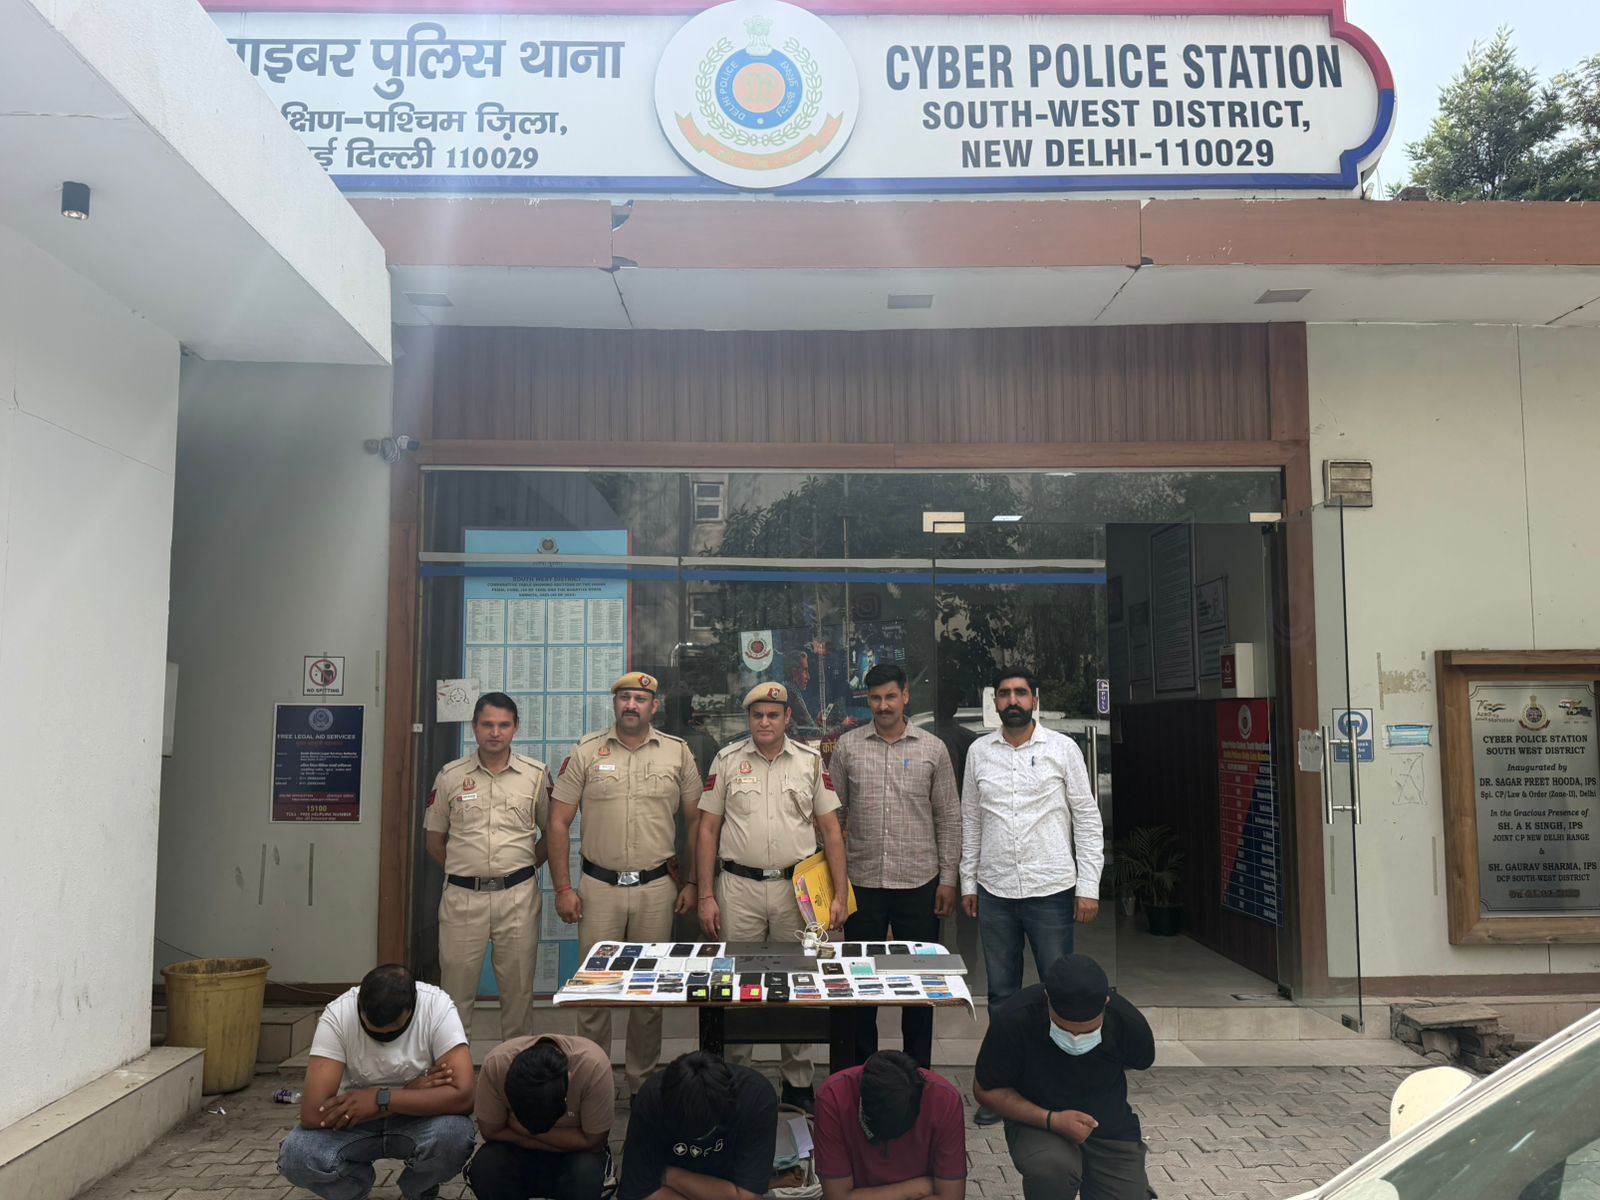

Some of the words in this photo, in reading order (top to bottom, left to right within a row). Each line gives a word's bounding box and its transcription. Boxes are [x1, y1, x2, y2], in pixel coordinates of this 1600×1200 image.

[370, 22, 506, 100] पुलिस
[519, 41, 625, 78] थाना
[885, 44, 1013, 91] CYBER
[1029, 44, 1168, 89] POLICE
[1183, 43, 1342, 89] STATION
[720, 60, 739, 95] POLICE
[720, 96, 746, 121] DELHI
[922, 100, 1138, 130] SOUTH-WEST
[1152, 99, 1311, 133] DISTRICT,
[345, 136, 437, 170] दिल्ली
[446, 146, 538, 169] 110029
[961, 140, 1033, 168] NEW
[1045, 138, 1275, 167] DELHI-110029
[1483, 735, 1513, 744] CYBER
[1516, 735, 1548, 744] POLICE
[1550, 734, 1588, 743] STATION
[1486, 747, 1516, 755] SOUTH
[1518, 746, 1543, 755] WEST
[1545, 746, 1586, 754] DISTRICT
[1507, 764, 1556, 773] Inaugurated
[1558, 764, 1568, 773] by
[1495, 778, 1522, 787] SAGAR
[1524, 778, 1550, 786] PREET
[1552, 777, 1583, 787] HOODA,
[1585, 777, 1597, 786] IPS
[1528, 790, 1547, 798] Order
[1580, 790, 1597, 798] Delhi
[1490, 809, 1498, 817] In
[1500, 809, 1512, 817] the
[1514, 808, 1546, 817] Gracious
[1548, 808, 1579, 816] Presence
[1580, 808, 1589, 818] of
[1498, 822, 1514, 830] SH.
[1516, 822, 1522, 830] A
[1525, 822, 1532, 830] K
[1534, 822, 1566, 832] SINGH,
[1568, 822, 1583, 830] IPS
[1488, 864, 1503, 872] SH.
[1505, 863, 1540, 872] GAURAV
[1584, 862, 1598, 870] IPS
